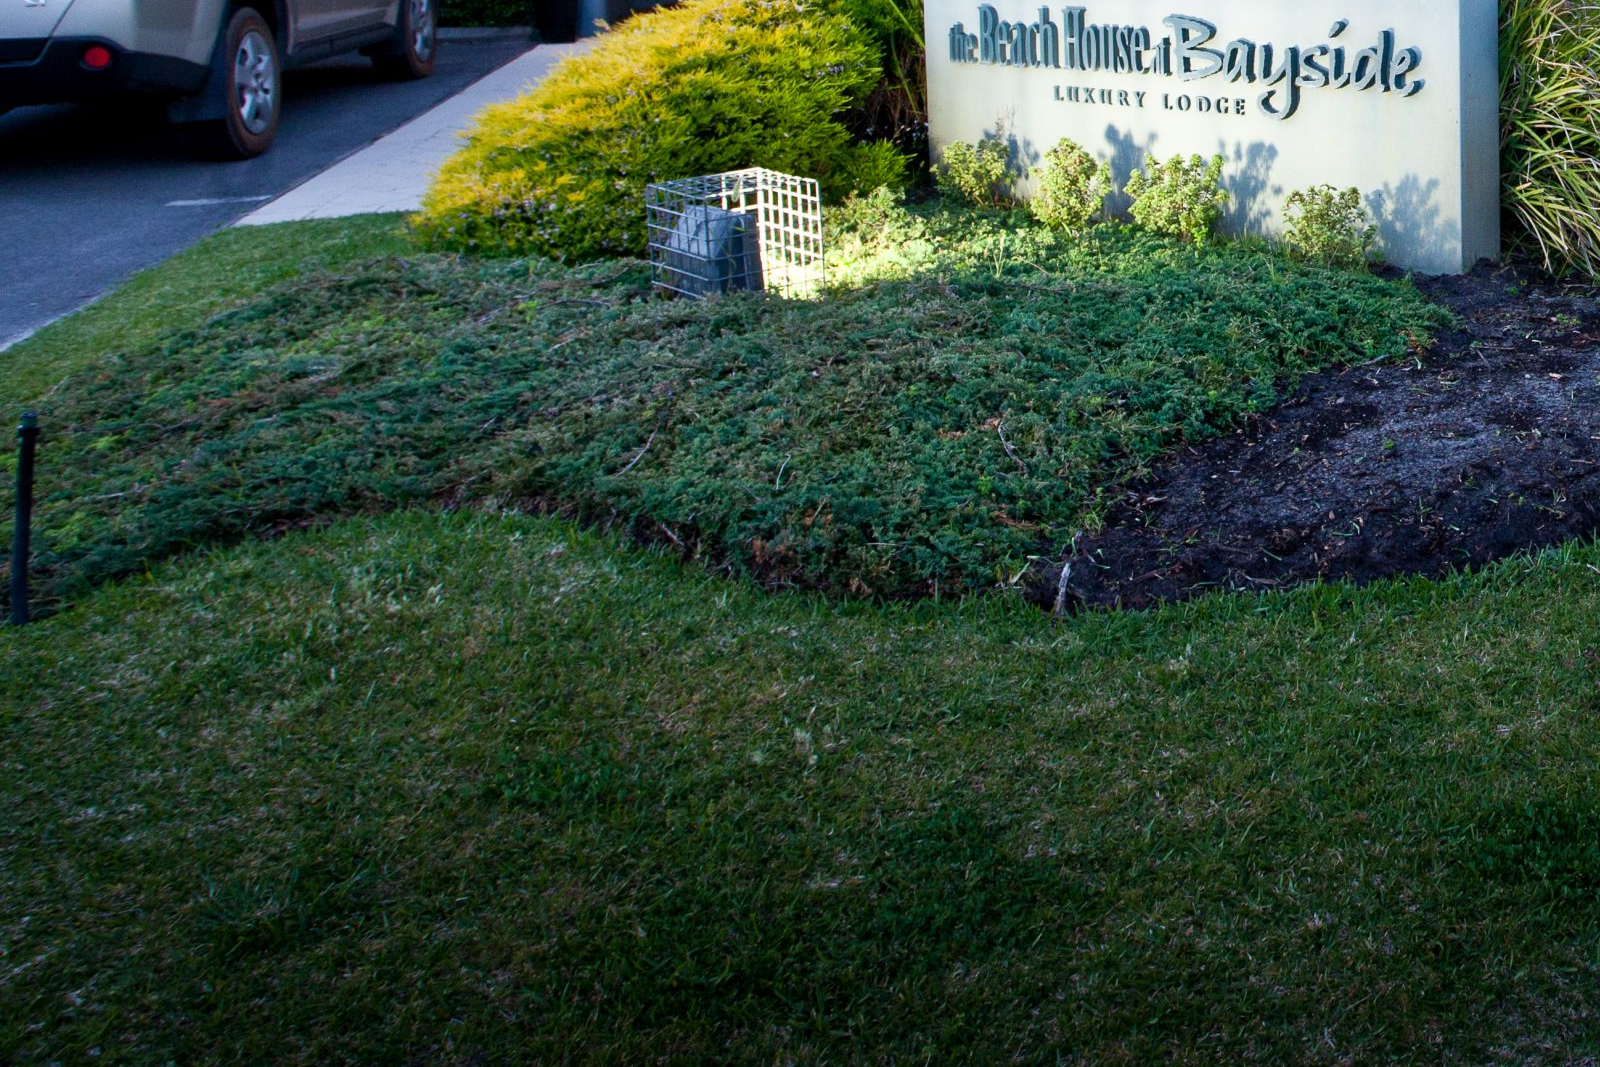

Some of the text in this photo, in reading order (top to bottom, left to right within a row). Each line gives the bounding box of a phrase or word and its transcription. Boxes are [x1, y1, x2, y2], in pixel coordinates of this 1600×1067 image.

[949, 21, 979, 64] the
[978, 3, 1060, 70] Beach
[1062, 5, 1150, 74] House
[1161, 13, 1427, 120] Bayside
[1053, 85, 1247, 116] LUXURY LODGE
